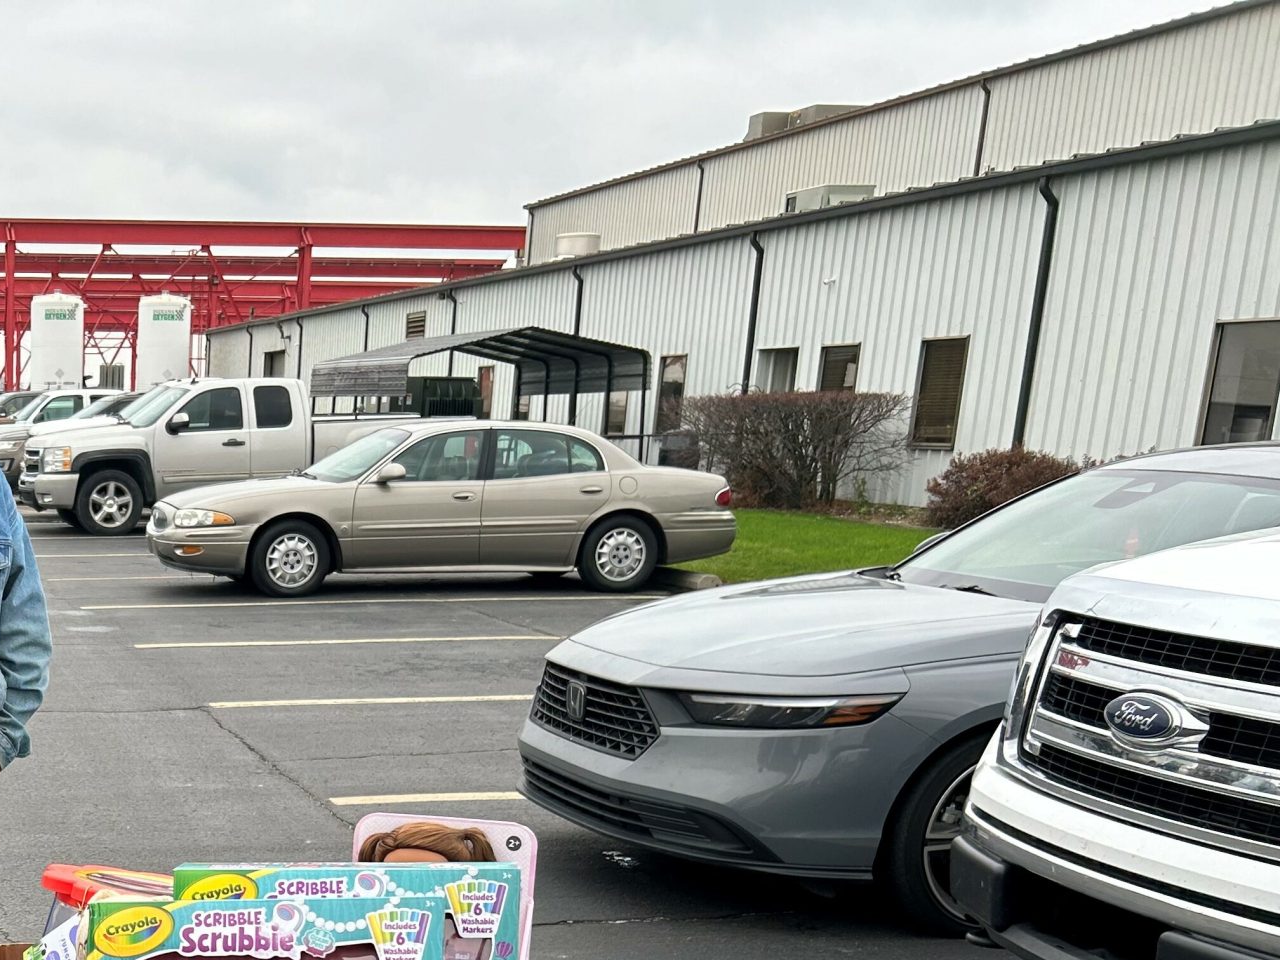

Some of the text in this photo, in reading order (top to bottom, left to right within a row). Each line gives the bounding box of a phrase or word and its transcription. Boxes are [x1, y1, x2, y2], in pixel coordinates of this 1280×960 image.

[1114, 700, 1158, 731] Ford
[508, 839, 520, 848] 2+
[192, 883, 243, 900] Crayola
[278, 880, 344, 895] SCRIBBLE
[462, 893, 494, 901] Includes
[473, 903, 483, 916] 6
[106, 915, 159, 936] Crayola
[194, 911, 262, 928] SCRIBBLE
[384, 922, 417, 930] Includes
[461, 918, 495, 926] Washable
[462, 925, 493, 934] Markers
[181, 924, 294, 953] Scrubbie
[395, 932, 406, 945] 6
